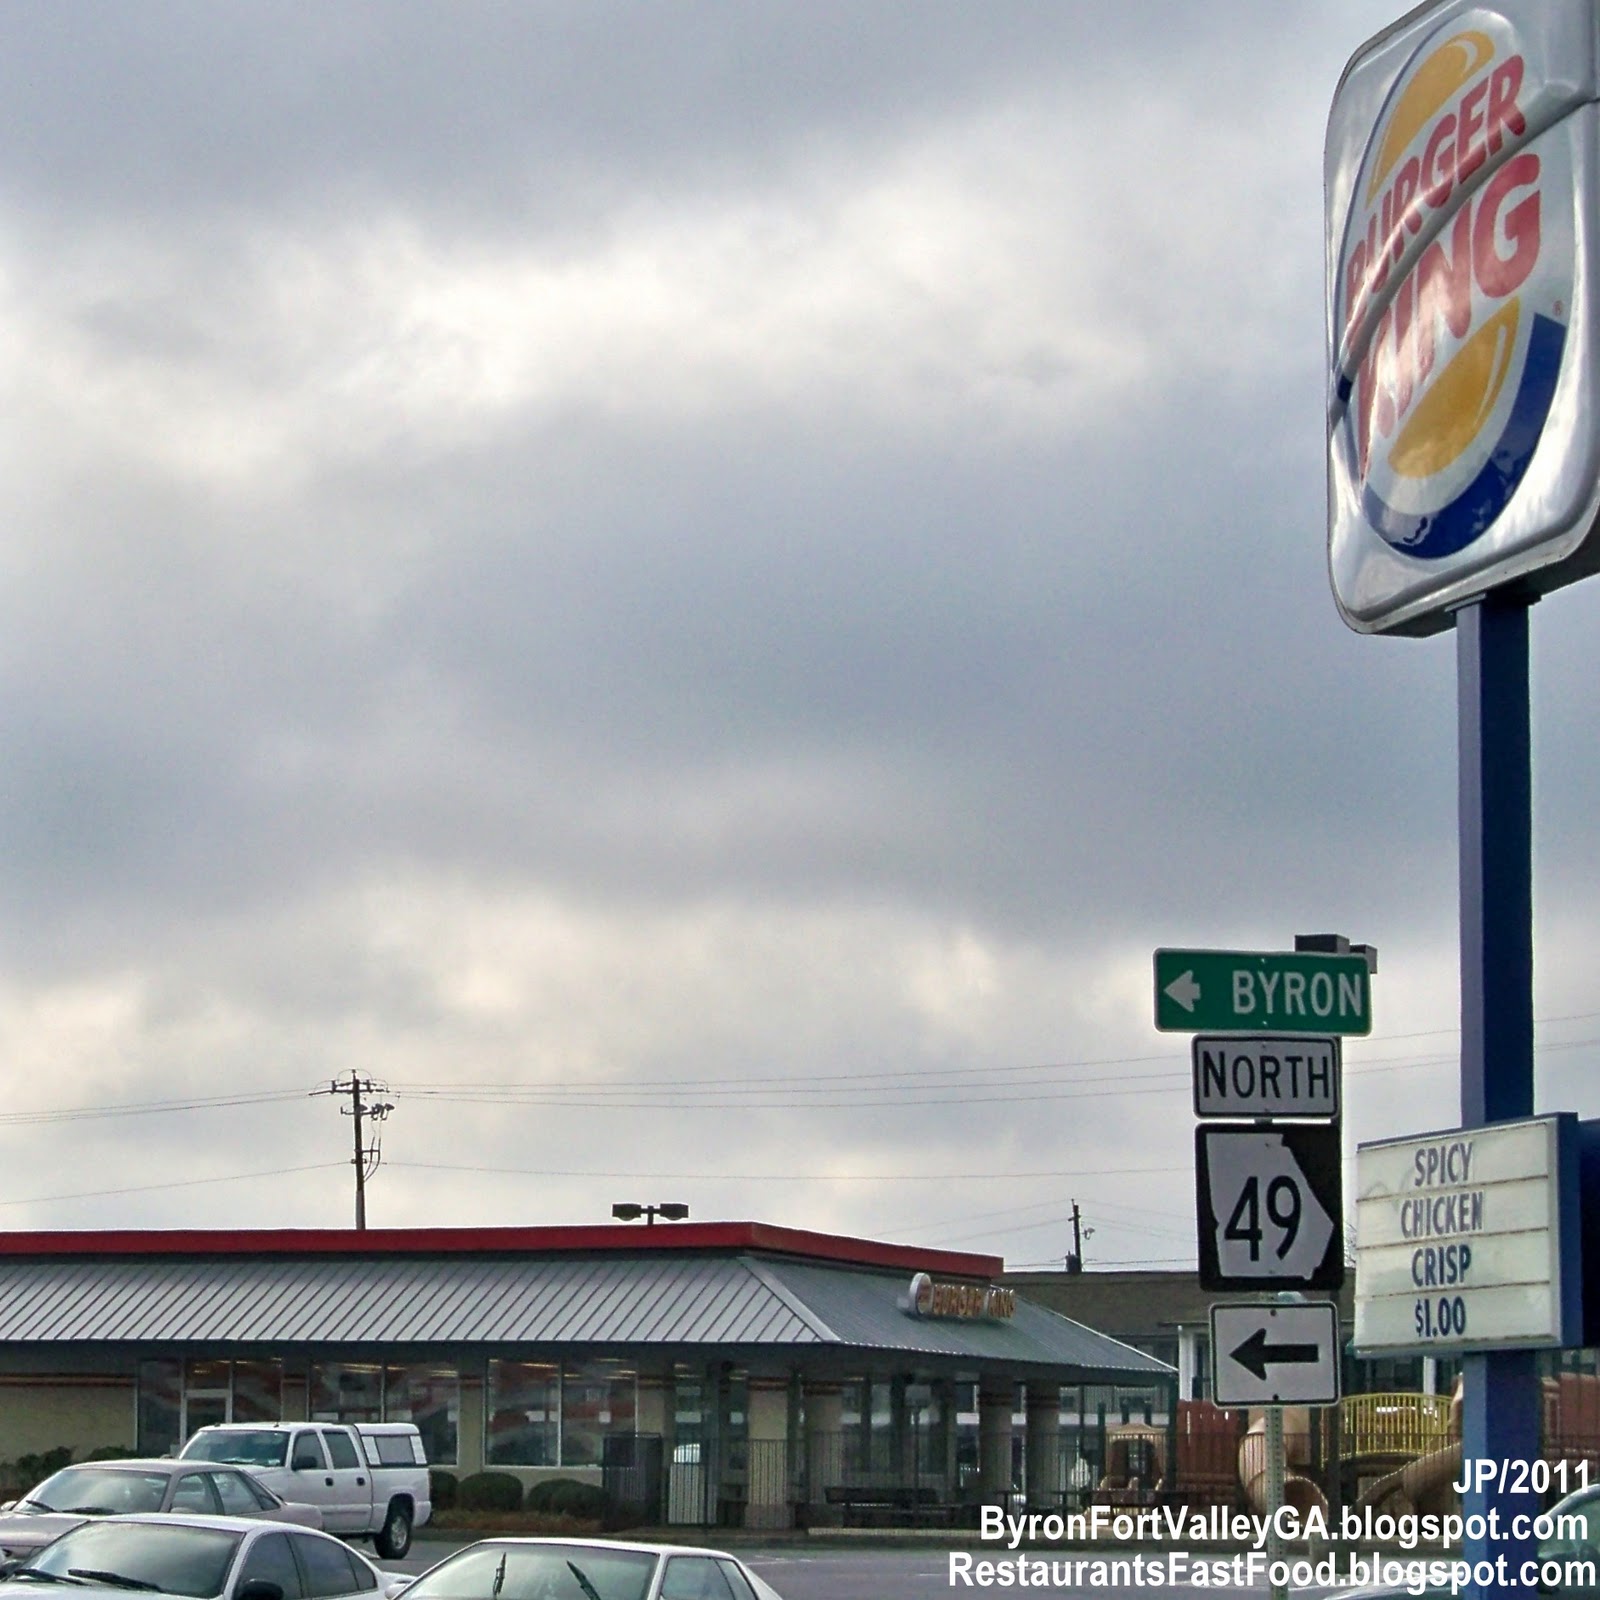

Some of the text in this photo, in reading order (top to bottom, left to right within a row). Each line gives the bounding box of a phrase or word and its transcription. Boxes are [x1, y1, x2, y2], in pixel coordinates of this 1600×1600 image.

[1341, 54, 1526, 356] BURGER
[1357, 152, 1541, 481] KING
[1232, 970, 1363, 1017] BYRON
[1202, 1050, 1330, 1099] NORTH
[1414, 1141, 1473, 1187] SPICY
[1224, 1174, 1302, 1262] 49
[1401, 1191, 1483, 1238] CHICKEN
[1411, 1245, 1472, 1287] CRISP
[1415, 1296, 1467, 1337] $1.00
